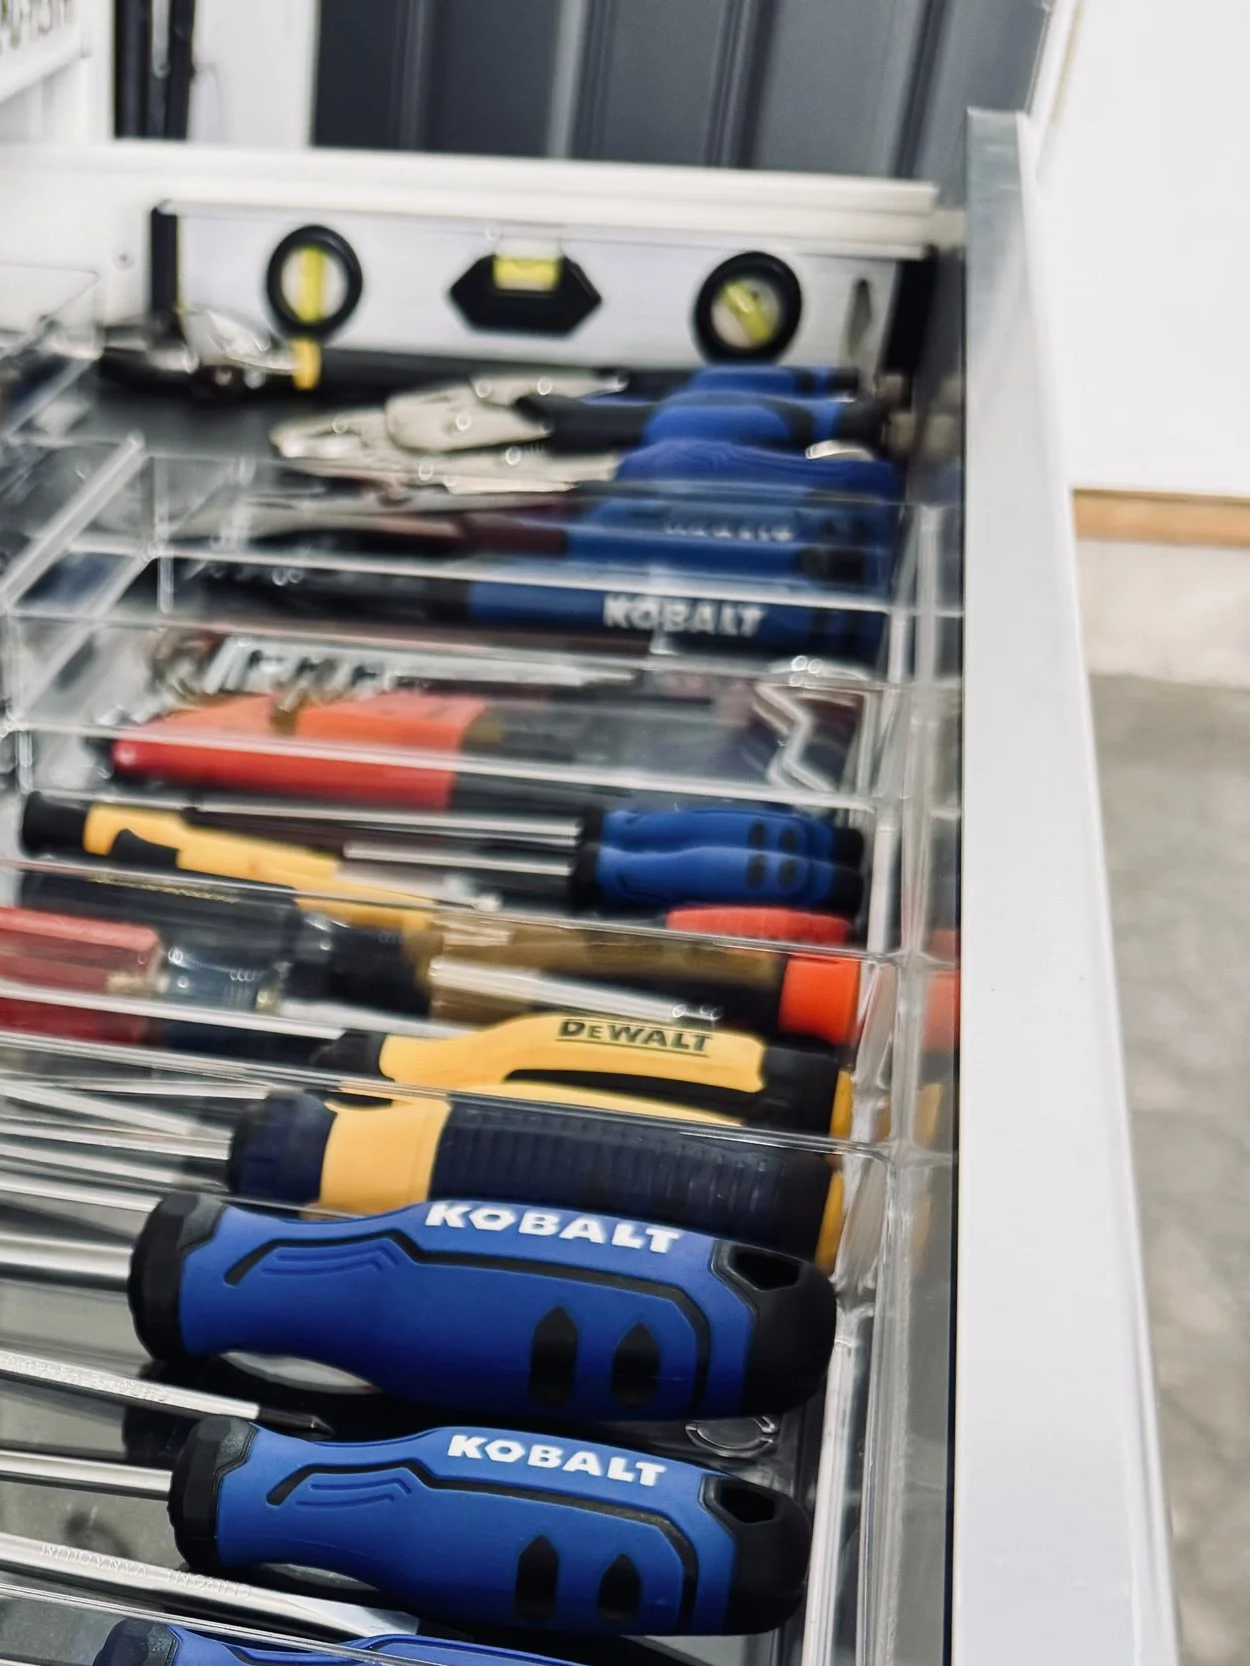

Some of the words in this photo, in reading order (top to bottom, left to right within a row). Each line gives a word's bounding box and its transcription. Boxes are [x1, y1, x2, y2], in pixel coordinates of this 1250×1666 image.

[603, 594, 766, 636] KOBALT
[425, 1201, 683, 1254] KOBALT
[447, 1434, 667, 1487] KOBALT
